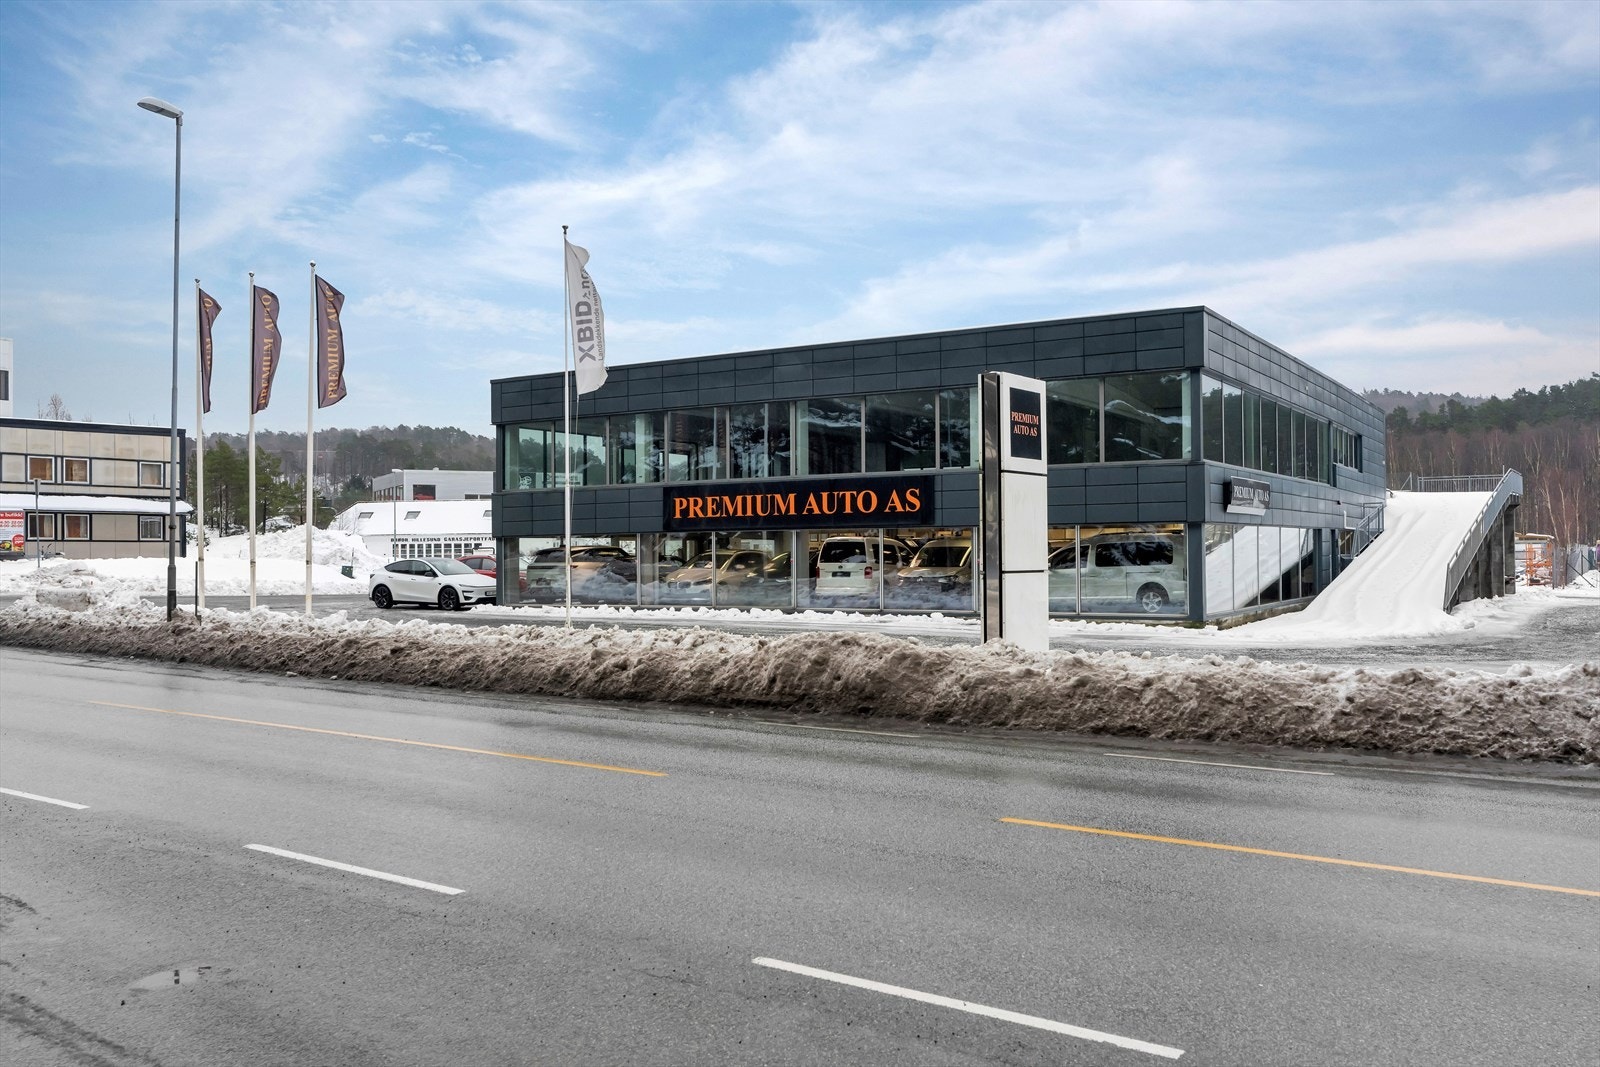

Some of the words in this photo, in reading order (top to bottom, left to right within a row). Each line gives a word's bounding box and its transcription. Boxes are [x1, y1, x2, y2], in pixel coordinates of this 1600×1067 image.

[575, 300, 596, 364] XBID
[259, 338, 274, 404] PREMIUM
[327, 328, 340, 400] PREMIUM
[1012, 412, 1039, 424] PREMIUM
[1014, 424, 1029, 436] AUTO
[1030, 427, 1038, 436] AS
[673, 492, 797, 519] PREMIUM
[802, 489, 878, 515] AUTO
[884, 487, 921, 513] AS
[1234, 486, 1254, 500] PREMIUM
[1264, 490, 1269, 502] AS
